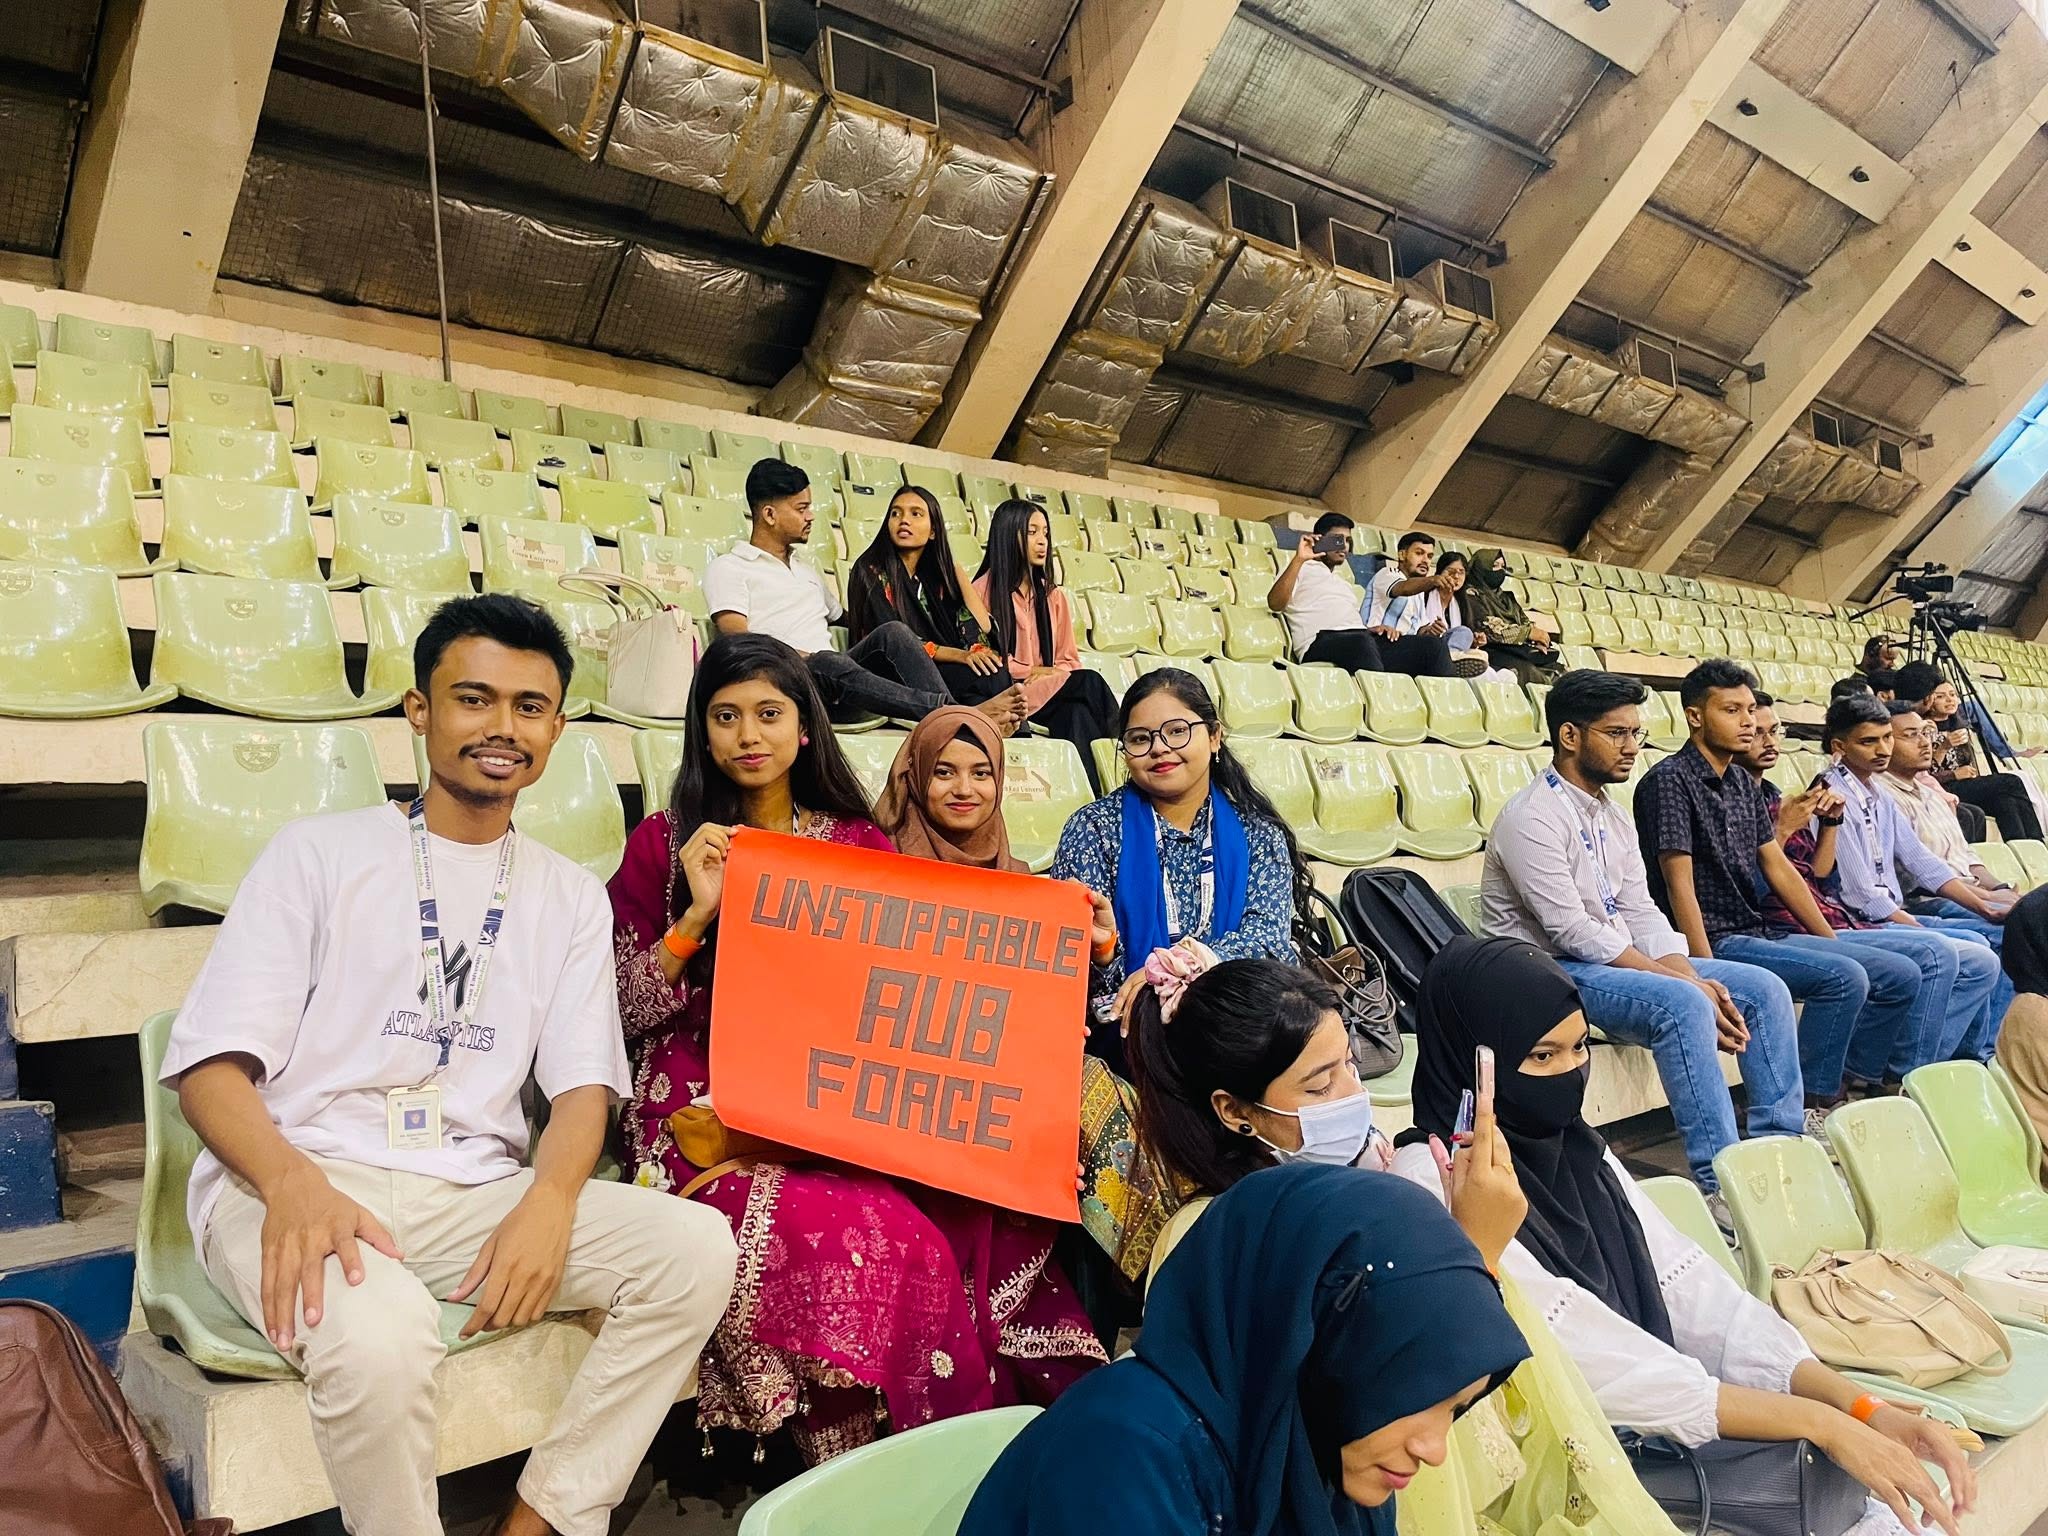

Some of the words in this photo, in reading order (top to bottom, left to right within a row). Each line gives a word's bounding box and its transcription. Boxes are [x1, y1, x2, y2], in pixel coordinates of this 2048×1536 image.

[750, 873, 1085, 977] UNSTOPPABLE
[437, 985, 445, 1021] University
[856, 966, 1012, 1067] AUB
[806, 1047, 1023, 1153] FORCE
